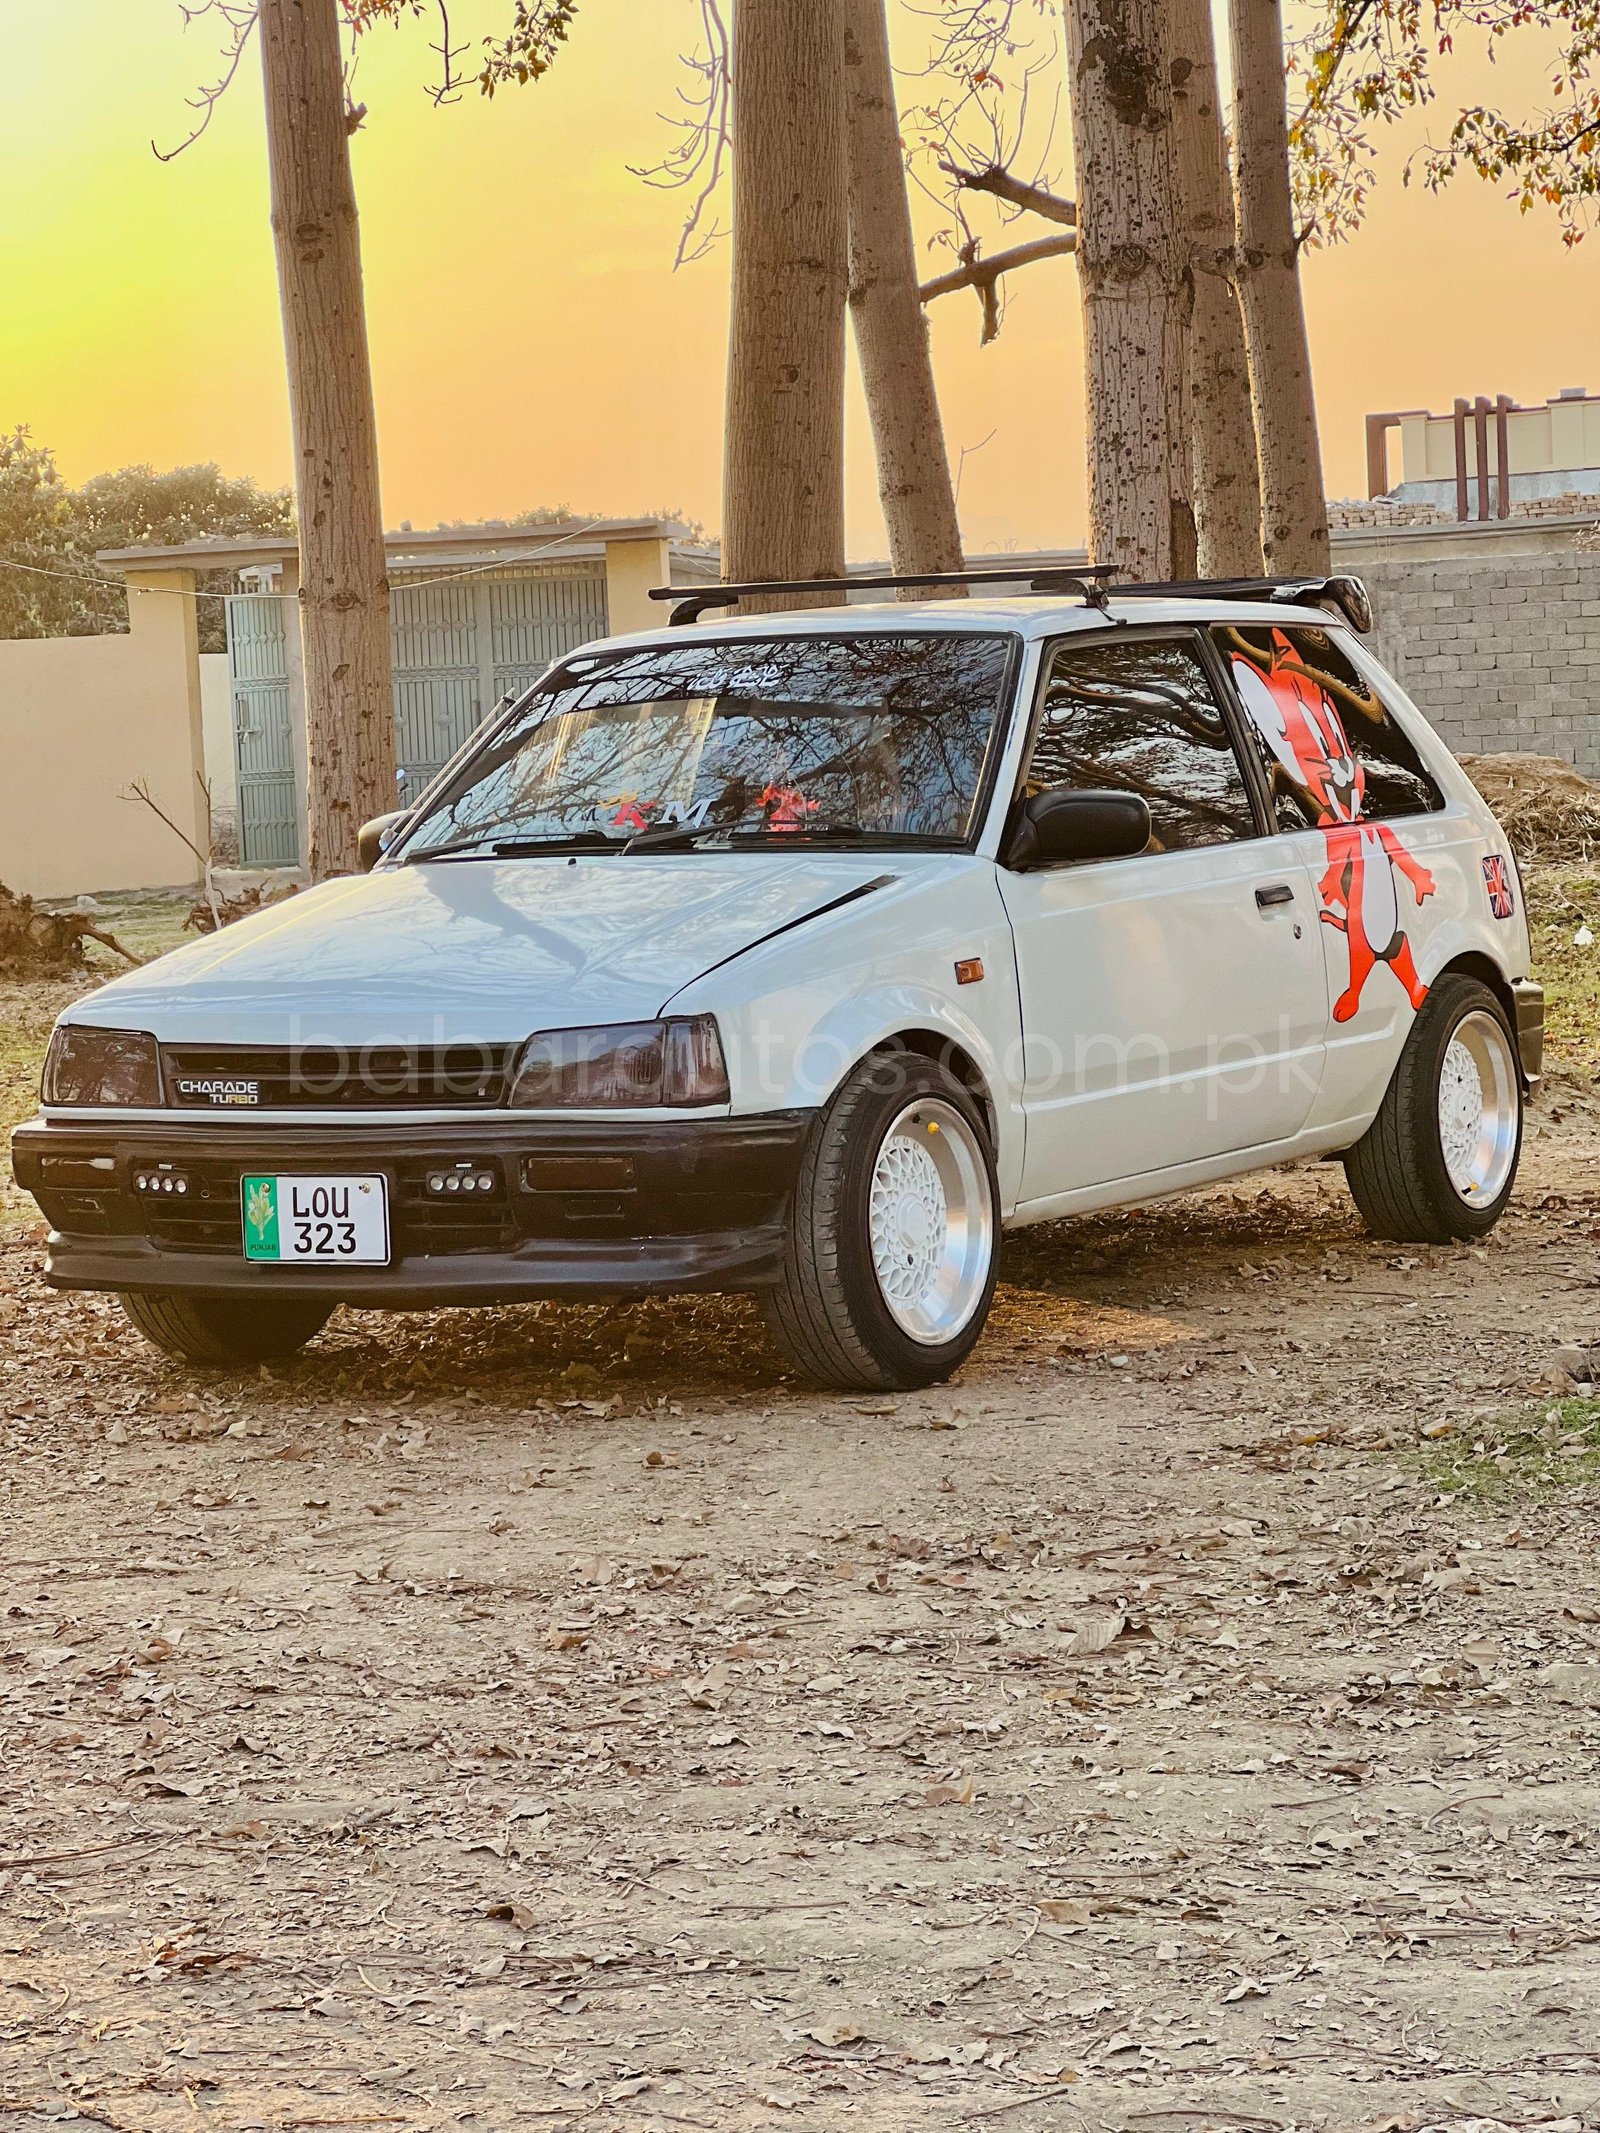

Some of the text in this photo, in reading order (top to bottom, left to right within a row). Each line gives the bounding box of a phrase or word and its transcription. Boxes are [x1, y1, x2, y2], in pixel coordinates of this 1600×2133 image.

[180, 1081, 258, 1094] CHARADE
[210, 1094, 258, 1104] TURBO
[292, 1186, 349, 1219] LOU
[293, 1222, 357, 1254] 323
[250, 1243, 277, 1251] PUNJAB
